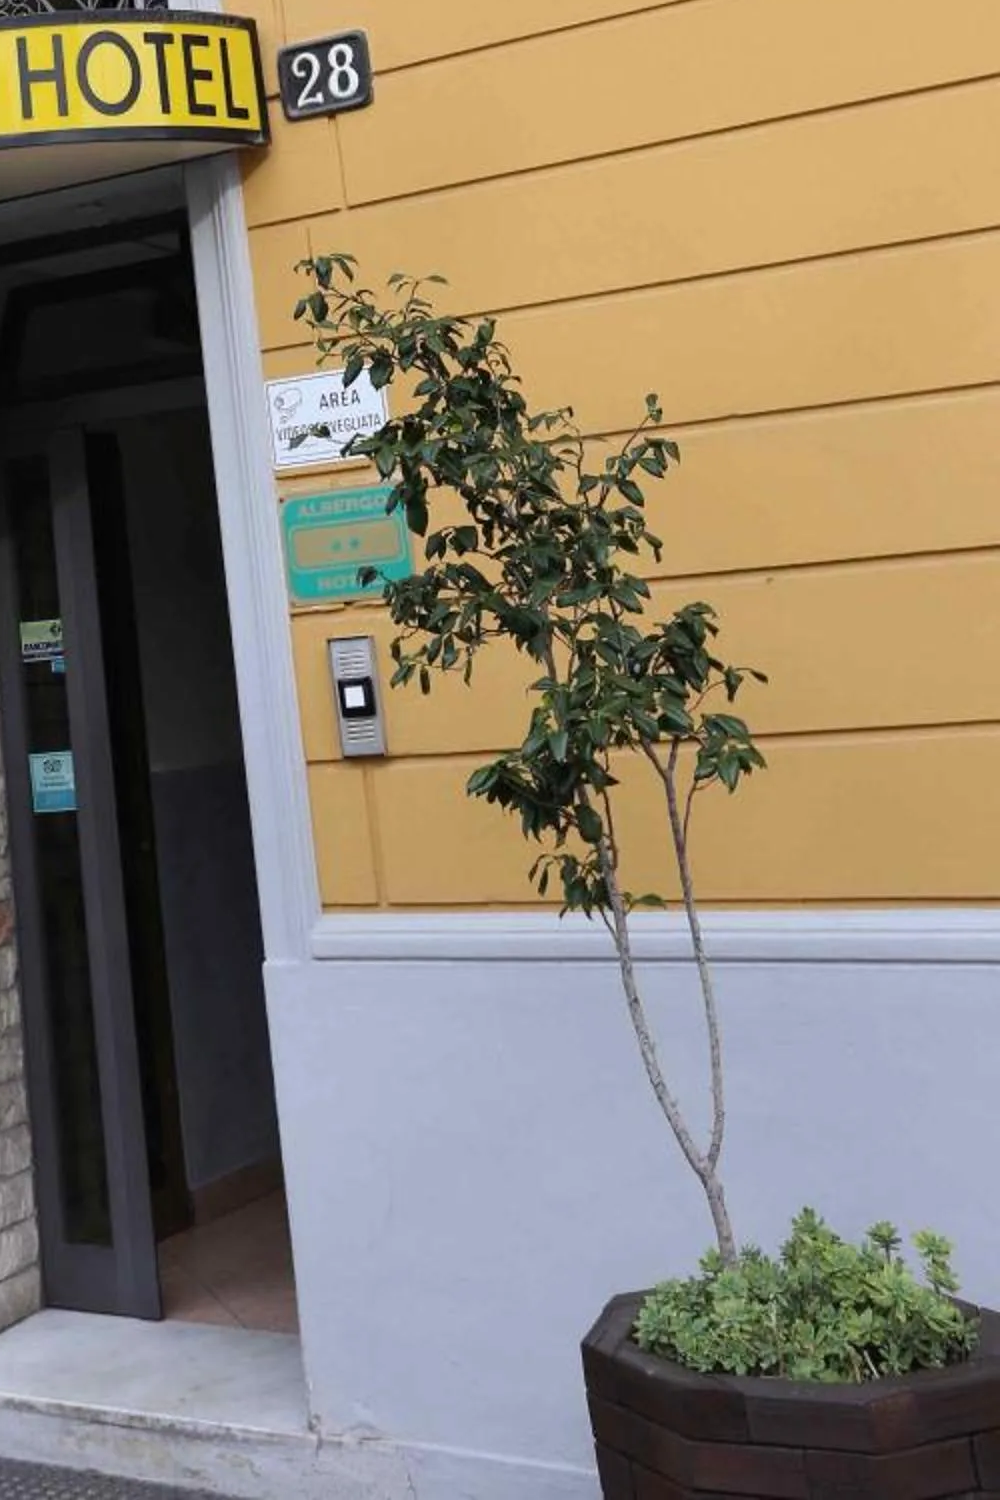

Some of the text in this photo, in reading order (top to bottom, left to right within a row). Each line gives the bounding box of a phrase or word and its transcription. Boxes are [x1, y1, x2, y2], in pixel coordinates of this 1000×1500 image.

[17, 30, 249, 121] HOTEL
[290, 42, 361, 108] 28
[319, 389, 360, 409] AREA
